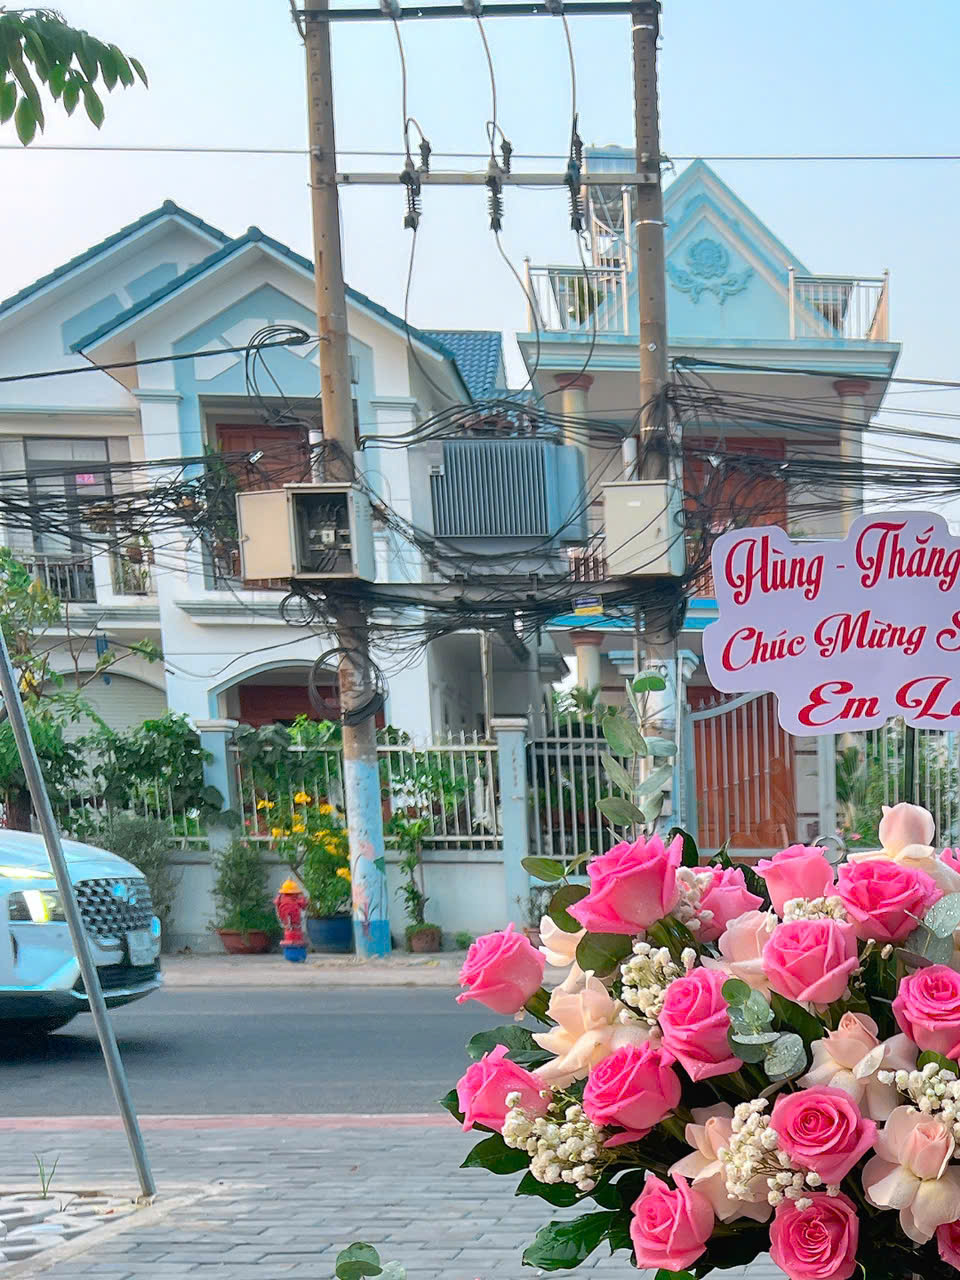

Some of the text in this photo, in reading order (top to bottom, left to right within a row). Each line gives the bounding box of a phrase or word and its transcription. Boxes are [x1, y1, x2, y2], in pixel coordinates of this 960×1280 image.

[725, 535, 824, 606] Hùng
[722, 626, 806, 672] Chúc
[813, 610, 927, 658] Mừng
[798, 681, 879, 727] Em
